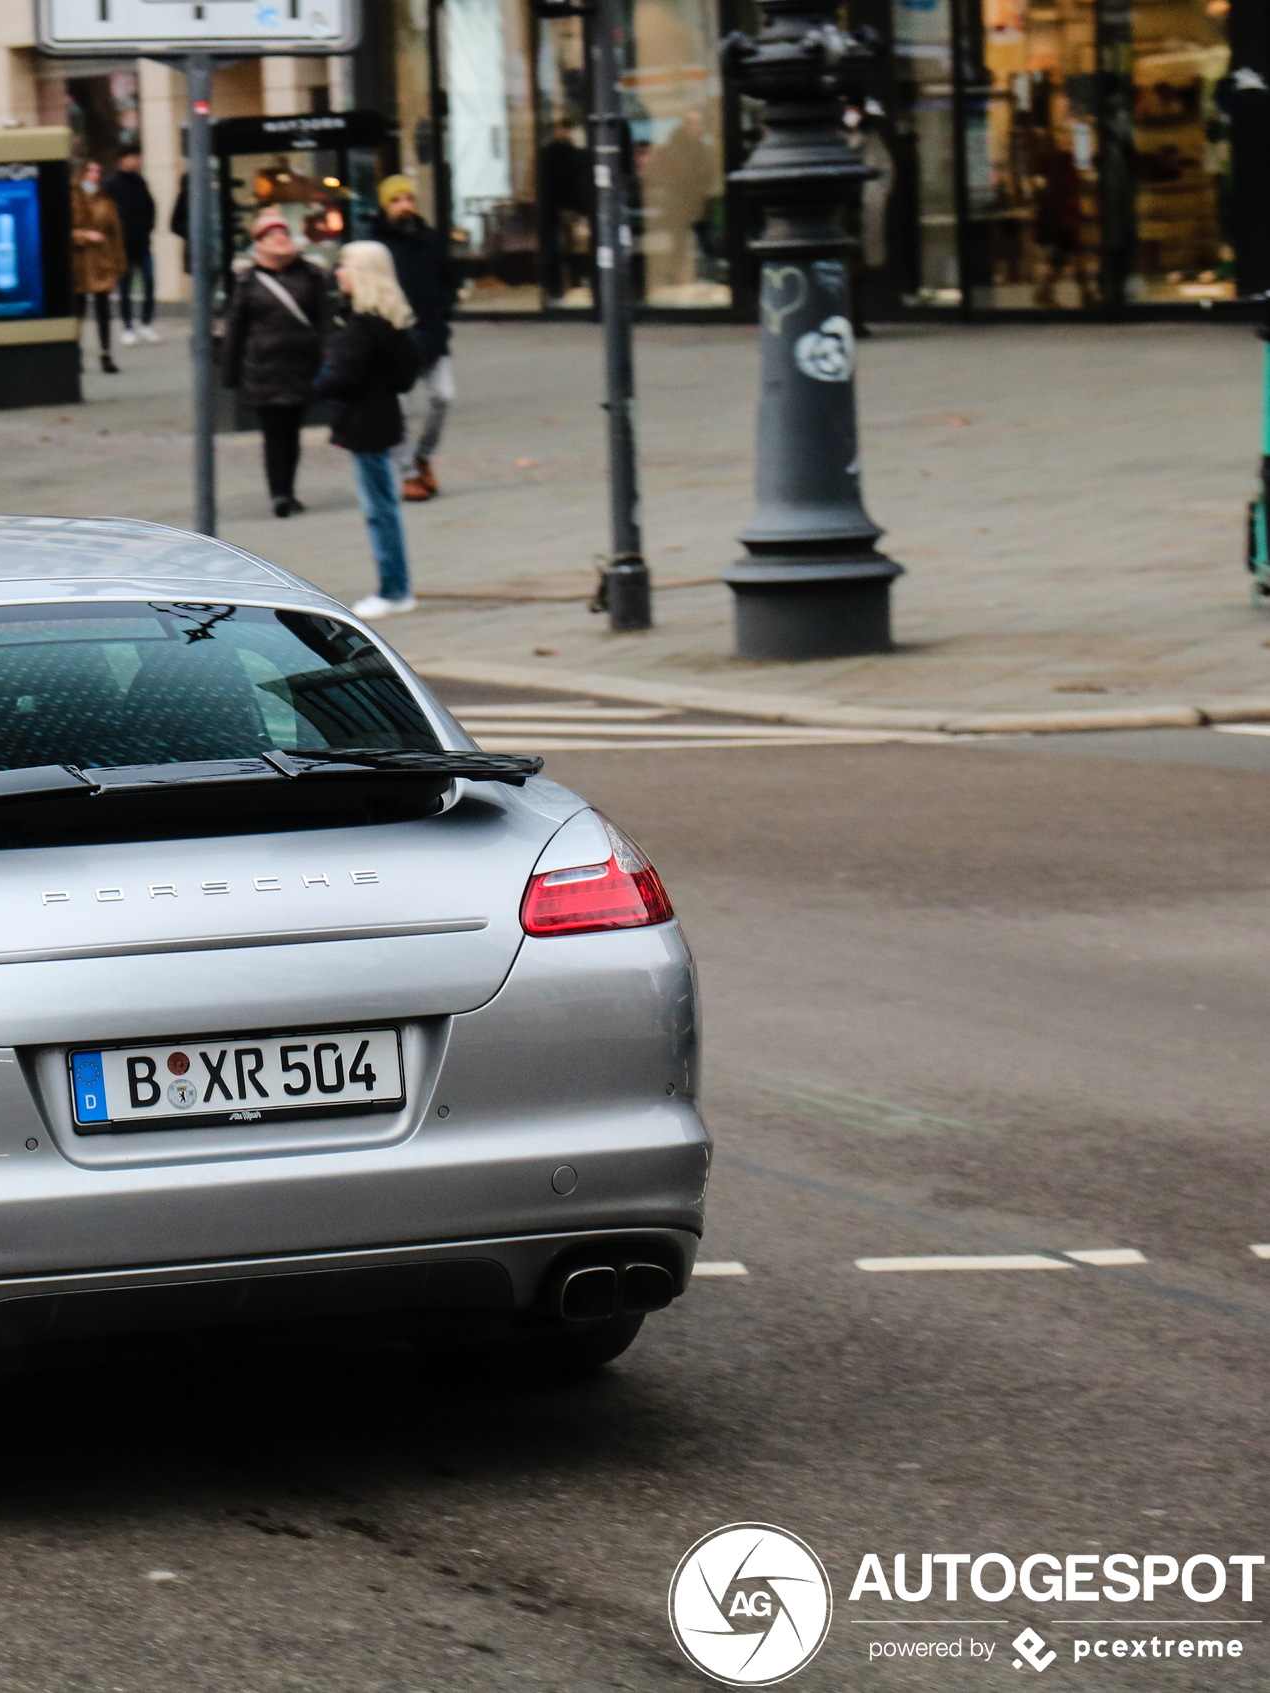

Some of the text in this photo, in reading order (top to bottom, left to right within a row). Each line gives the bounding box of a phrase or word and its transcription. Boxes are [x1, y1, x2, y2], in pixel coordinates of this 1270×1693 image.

[41, 869, 380, 906] PORSCHE
[126, 1055, 161, 1108] B
[198, 1047, 270, 1103] XR
[279, 1039, 377, 1097] 504
[85, 1094, 98, 1110] D
